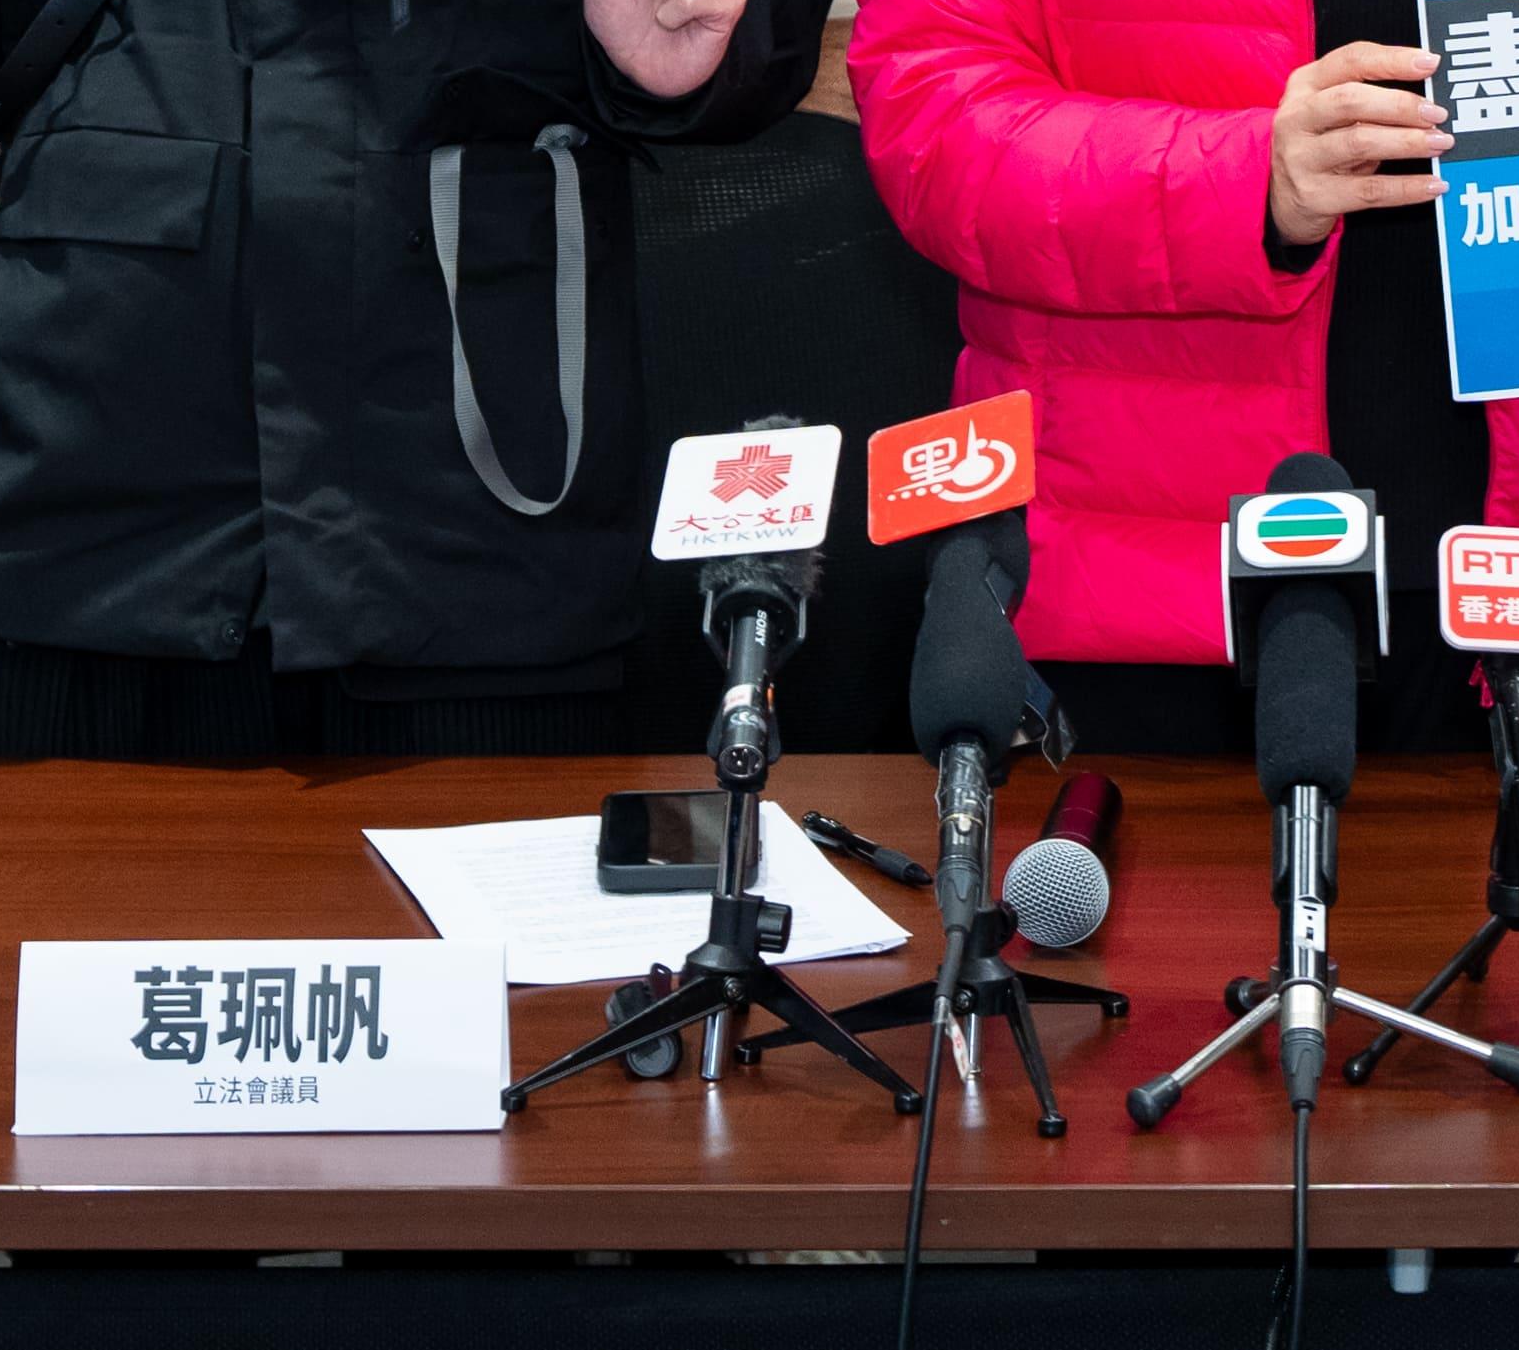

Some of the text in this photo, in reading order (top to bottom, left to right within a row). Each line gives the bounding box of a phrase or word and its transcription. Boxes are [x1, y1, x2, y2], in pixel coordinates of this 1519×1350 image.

[669, 503, 814, 532] 大公文匯
[682, 527, 798, 545] HKTKWW
[755, 609, 767, 646] SONY
[130, 964, 388, 1064] 葛珮帆
[193, 1076, 319, 1106] 立法會議員
